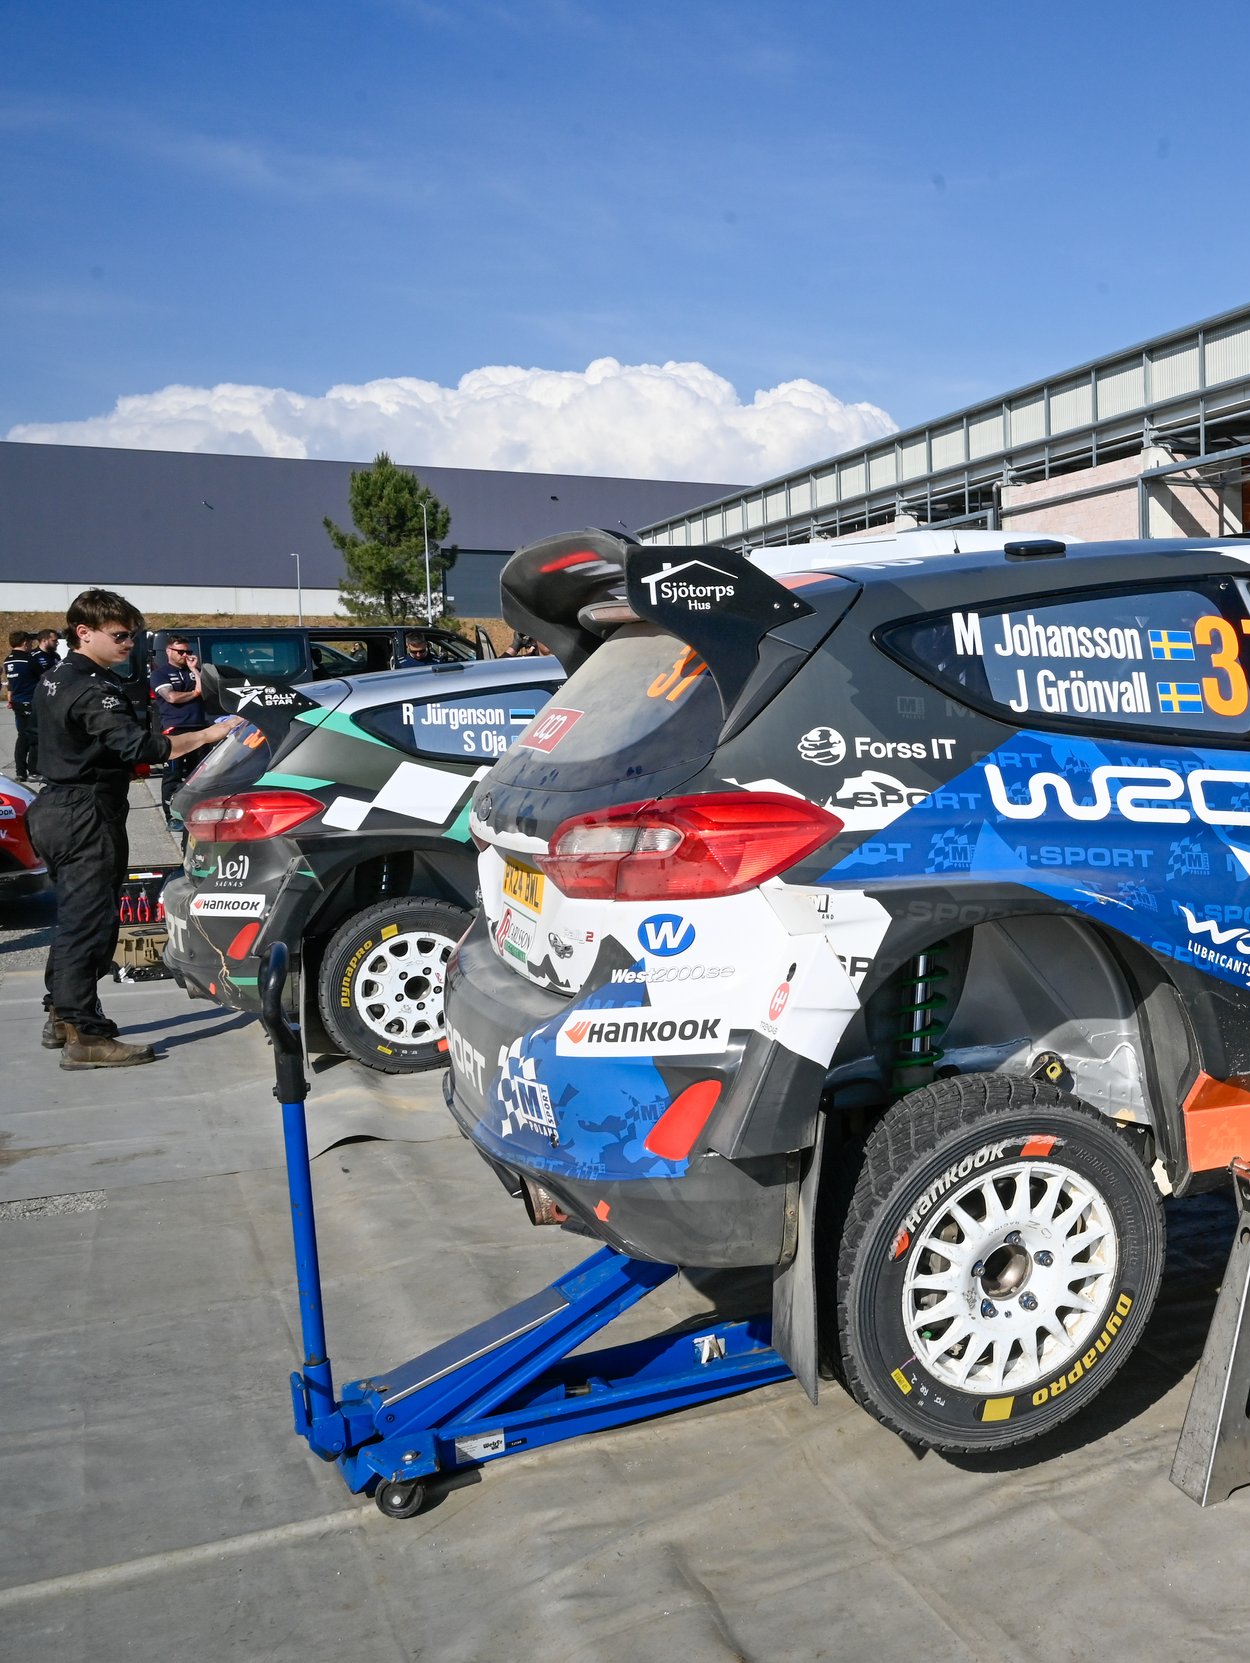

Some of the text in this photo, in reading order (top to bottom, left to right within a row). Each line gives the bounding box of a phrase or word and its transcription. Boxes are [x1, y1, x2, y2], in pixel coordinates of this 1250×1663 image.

[660, 582, 735, 604] Sjötorps
[688, 600, 711, 610] Hus
[952, 612, 1143, 660] M Johansson
[265, 693, 296, 701] RALLY
[1010, 669, 1151, 713] J Grönvall
[402, 703, 505, 730] R Jürgenson
[463, 731, 507, 757] S Oja
[855, 737, 956, 760] Forss IT
[217, 855, 250, 880] Leil
[645, 921, 691, 950] W
[610, 964, 736, 984] West2000.se
